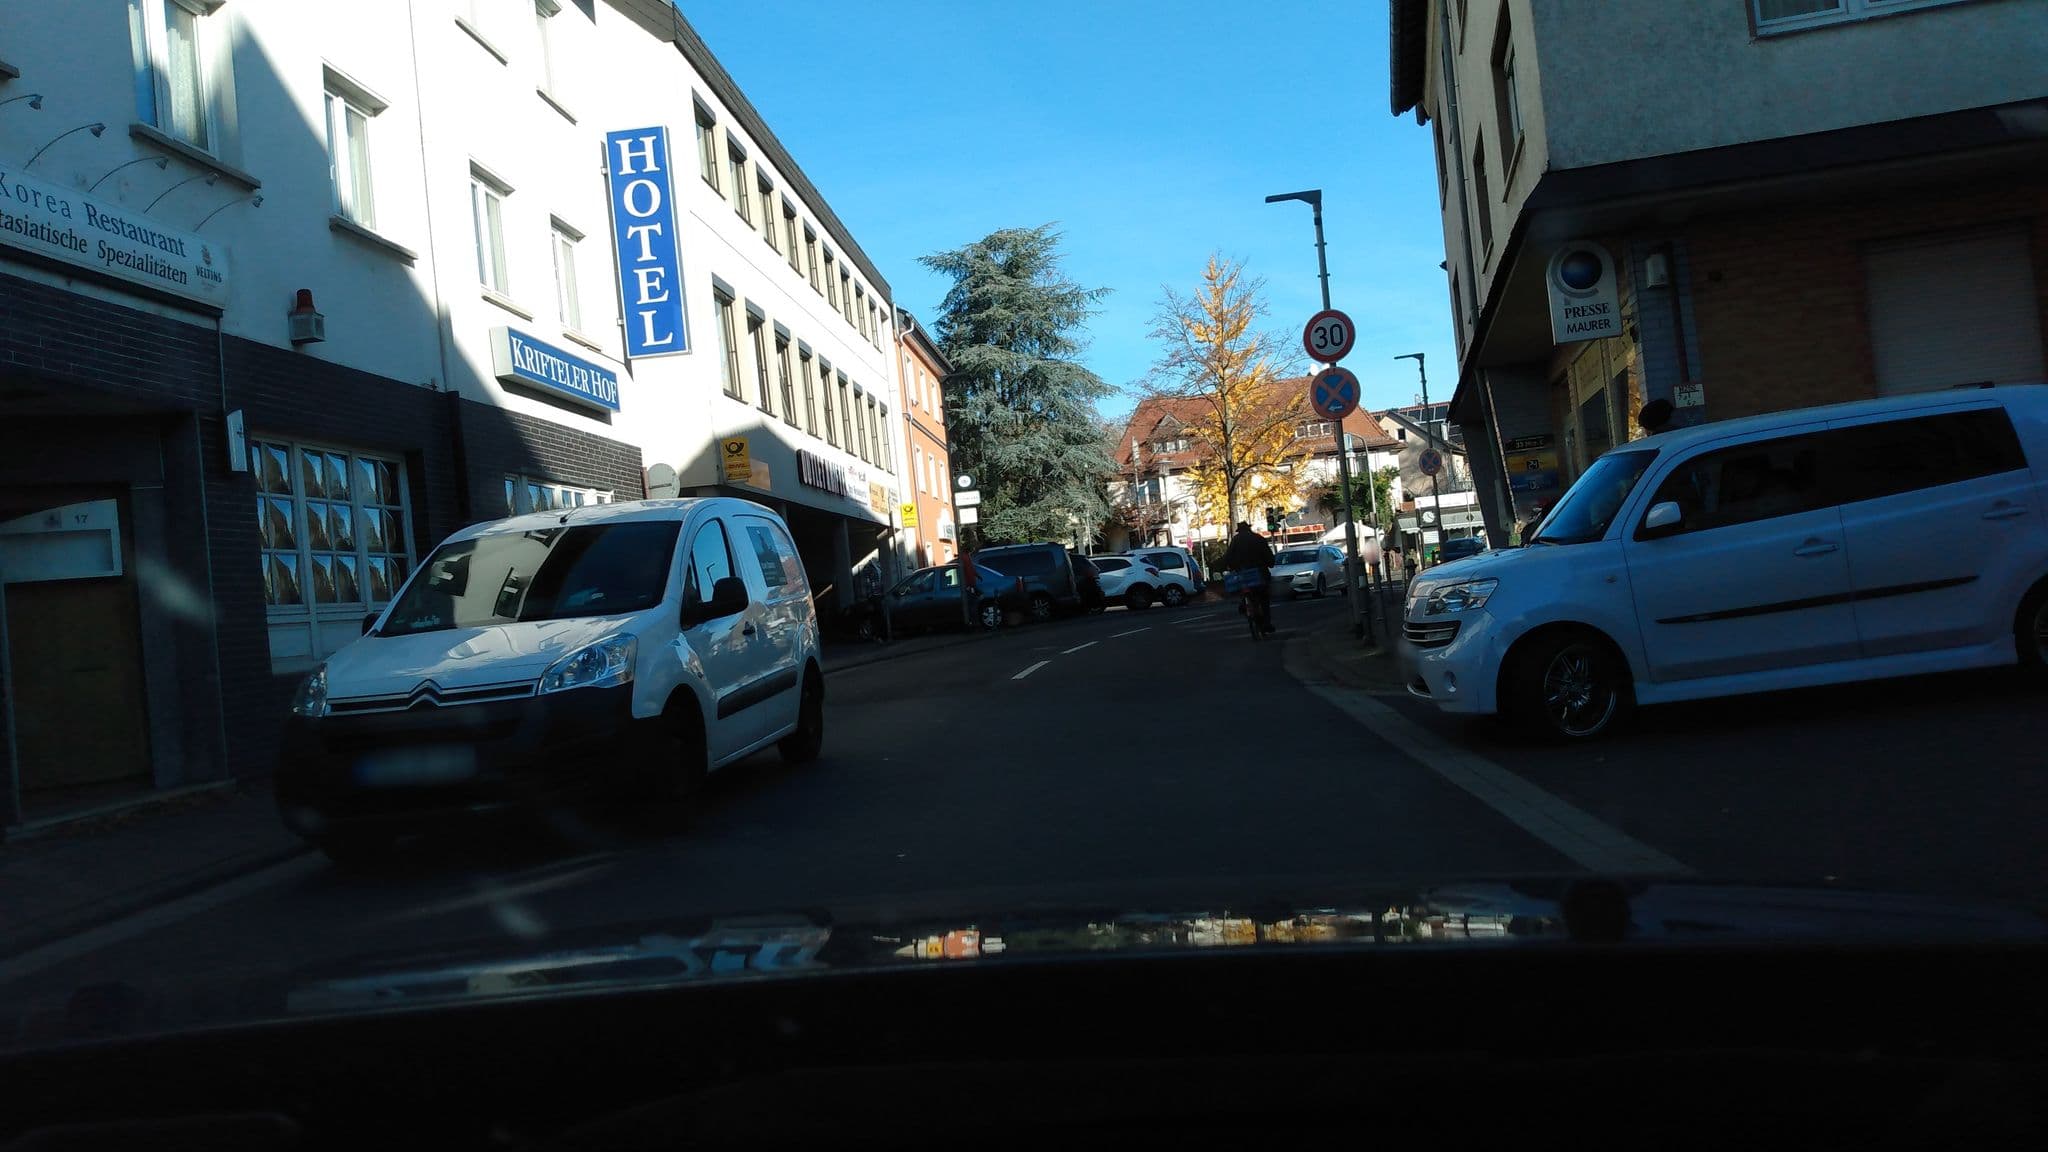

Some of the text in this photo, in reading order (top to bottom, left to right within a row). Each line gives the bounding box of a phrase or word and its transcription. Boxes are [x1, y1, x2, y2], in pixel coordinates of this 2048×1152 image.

[83, 201, 187, 258] Restaurant
[615, 135, 674, 348] HOTEL
[97, 239, 188, 285] Spezialitäten
[195, 265, 222, 283] VELTINS
[1564, 302, 1611, 320] PRESSE
[1566, 318, 1611, 335] MAURER
[1314, 323, 1344, 350] 30
[510, 335, 617, 404] KRIFTELER HOF
